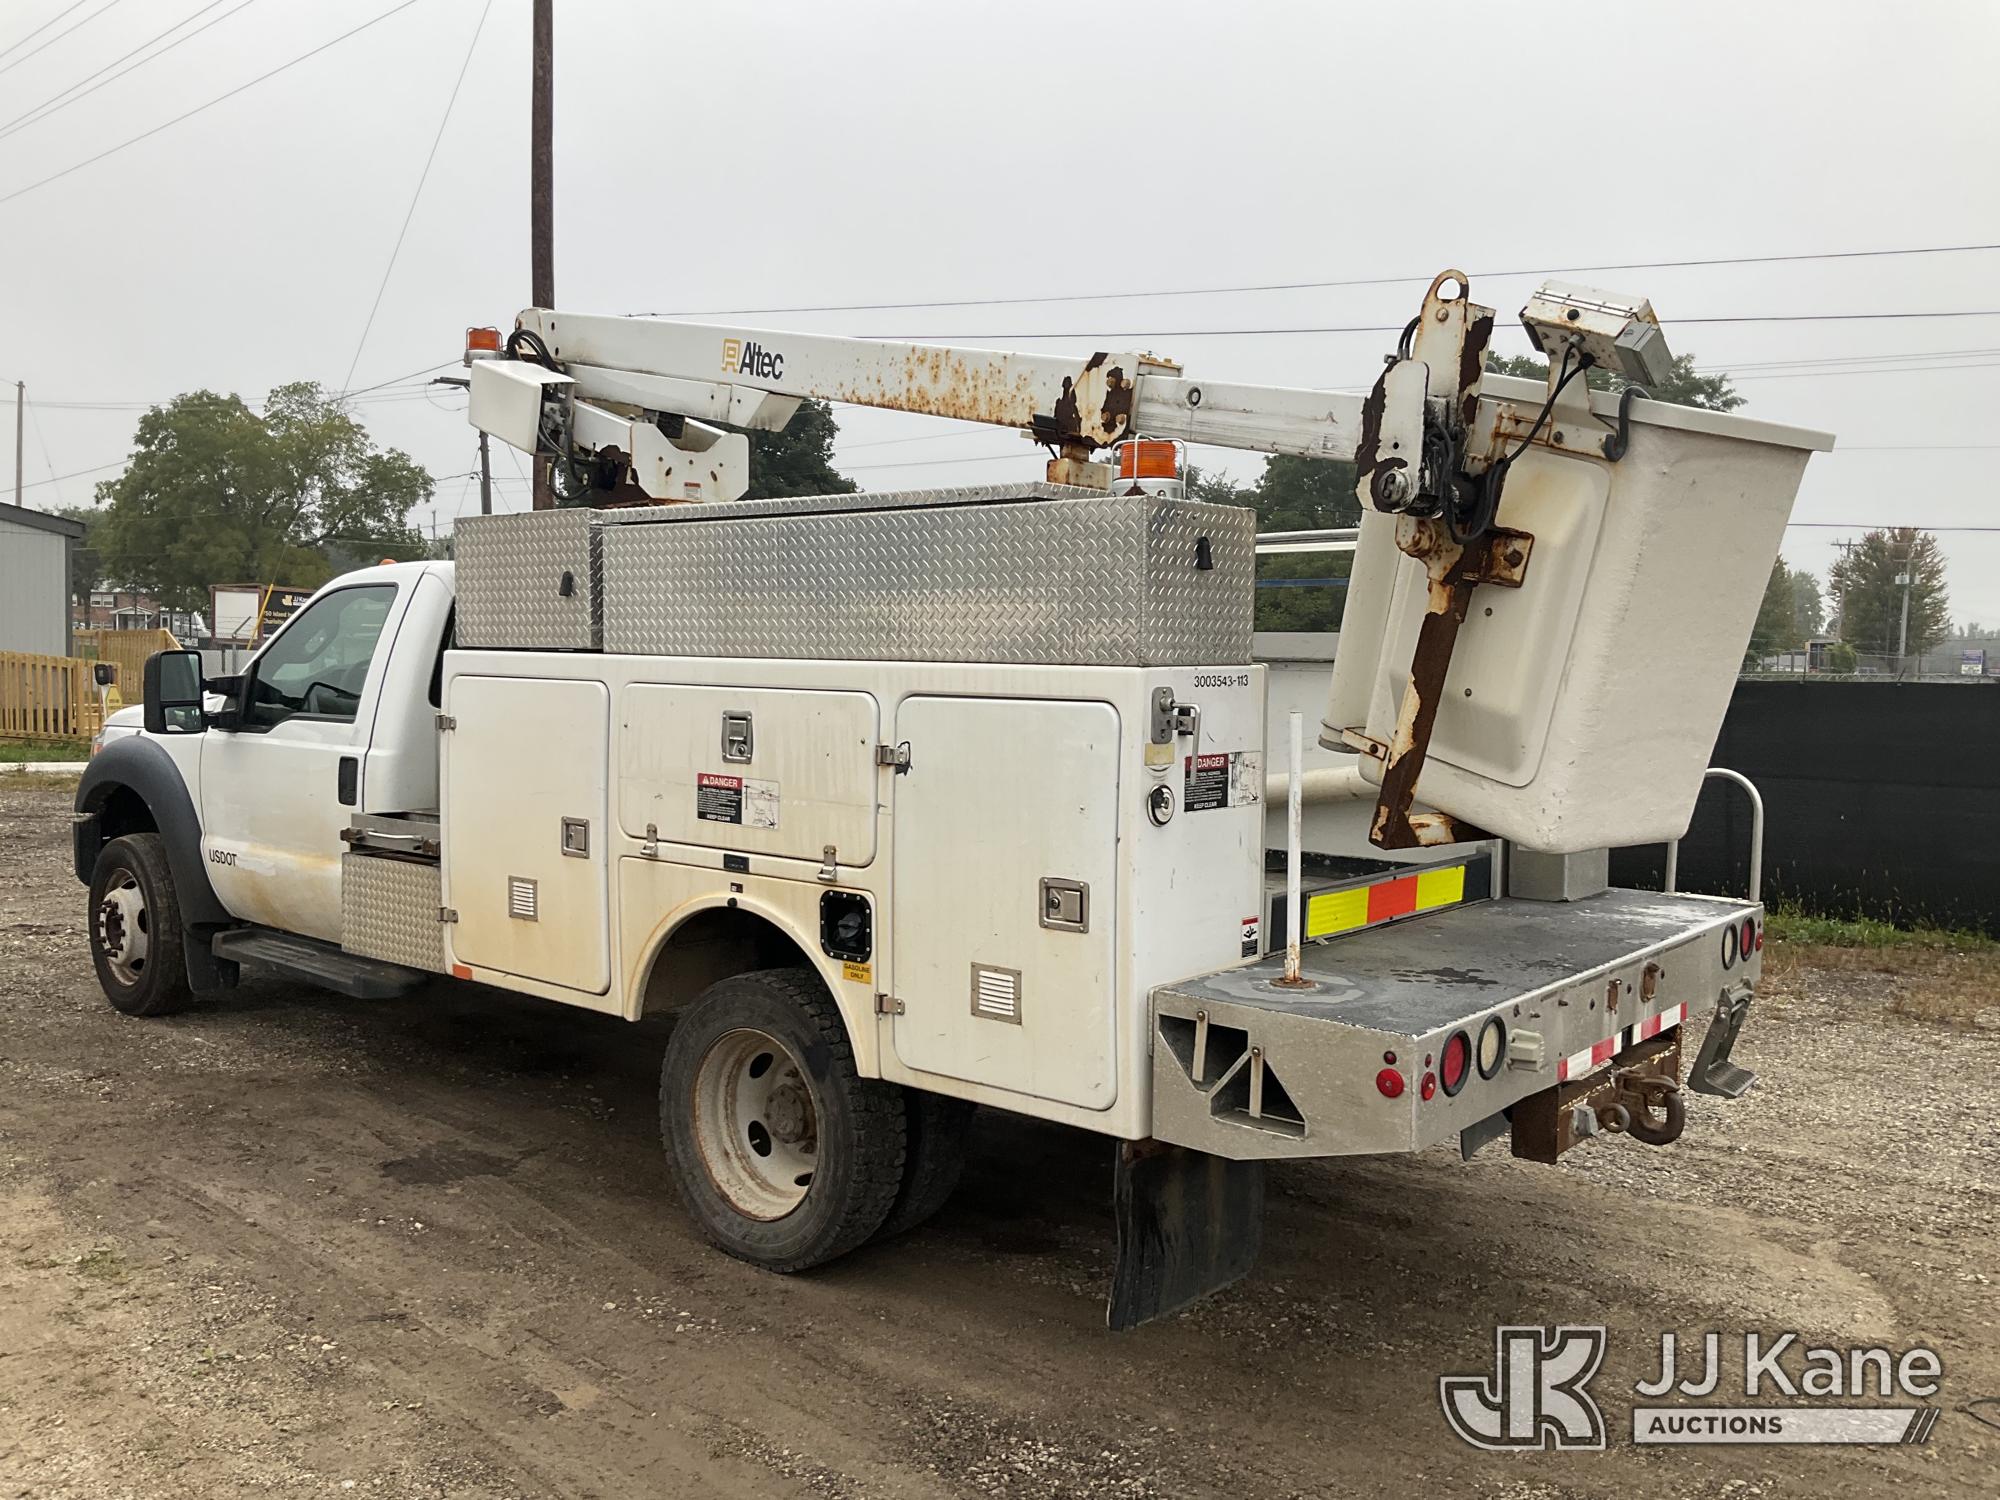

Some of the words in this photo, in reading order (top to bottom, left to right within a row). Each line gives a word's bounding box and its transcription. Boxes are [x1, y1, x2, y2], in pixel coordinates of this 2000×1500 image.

[739, 341, 784, 380] Altec
[1194, 674, 1249, 688] 3003543-113
[1197, 756, 1225, 768] DANGER
[709, 776, 738, 788] DANGER
[209, 849, 237, 867] USDOT
[843, 963, 870, 973] GASOLINE
